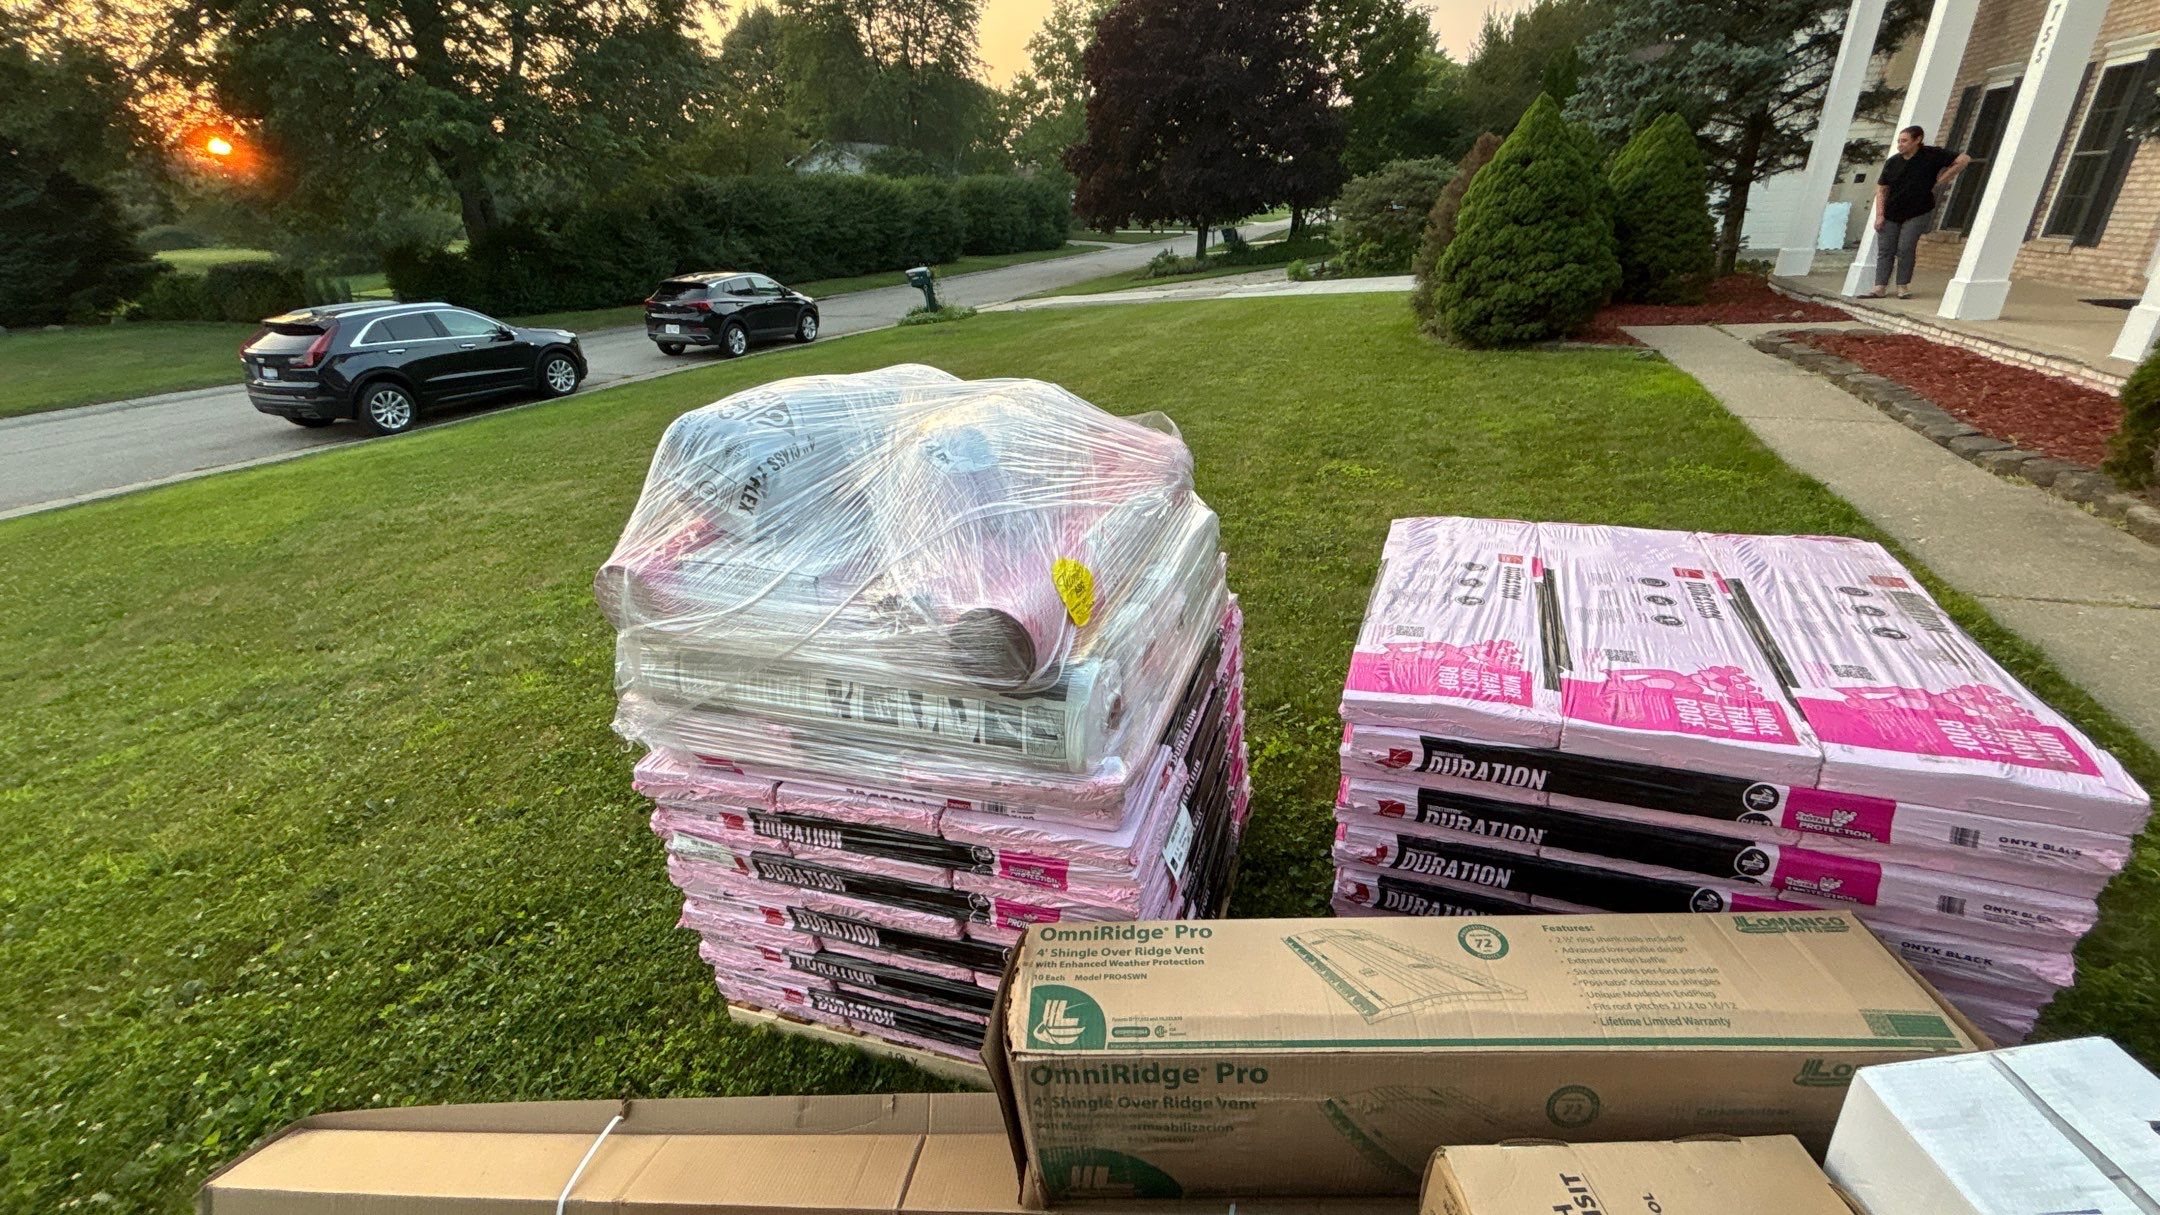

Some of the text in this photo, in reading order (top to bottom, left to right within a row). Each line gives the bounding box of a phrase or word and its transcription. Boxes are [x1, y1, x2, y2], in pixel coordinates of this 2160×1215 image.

[1438, 665, 1461, 692] ROOF
[1673, 696, 1707, 730] ROOF
[1722, 705, 1758, 735] THAN
[1933, 717, 1987, 755] ROOF
[1994, 727, 2046, 762] THAN
[1425, 755, 1548, 791] DURATION
[758, 819, 844, 849] DURATION
[1422, 810, 1545, 845] DURATION
[1798, 821, 1872, 839] PROTECTION
[1998, 836, 2039, 849] ONYX
[758, 861, 847, 893] DURATION
[1397, 851, 1512, 889] DURATION
[1983, 903, 2020, 917] ONYX
[796, 913, 881, 948] DURATION
[1175, 924, 1213, 939] Pro
[1541, 924, 1596, 933] Features:
[1474, 938, 1493, 948] 72
[1562, 946, 1606, 954] Advanced
[1036, 945, 1205, 960] 4' Shingle Over Ridge Vent
[1901, 941, 1994, 967] ONYX BLACK
[1036, 957, 1205, 969] with Enhanced Weather Protection
[1588, 967, 1613, 975] drain
[1614, 967, 1640, 975] holes
[1045, 973, 1066, 982] Each
[1074, 973, 1102, 981] Model
[1629, 979, 1667, 987] contour
[1680, 978, 1721, 987] shingles
[1586, 990, 1622, 999] Unique
[814, 995, 897, 1028] DURATION
[1592, 1002, 1612, 1011] Fits
[1612, 1002, 1633, 1010] roof
[1633, 1001, 1670, 1012] pitches
[1670, 1001, 1693, 1010] 2/12
[1599, 1016, 1731, 1028] Lifetime Limited Warranty
[1215, 1061, 1269, 1085] Pro
[1051, 1095, 1111, 1112] Shingle
[1117, 1096, 1158, 1109] Over
[1162, 1095, 1213, 1111] Ridge
